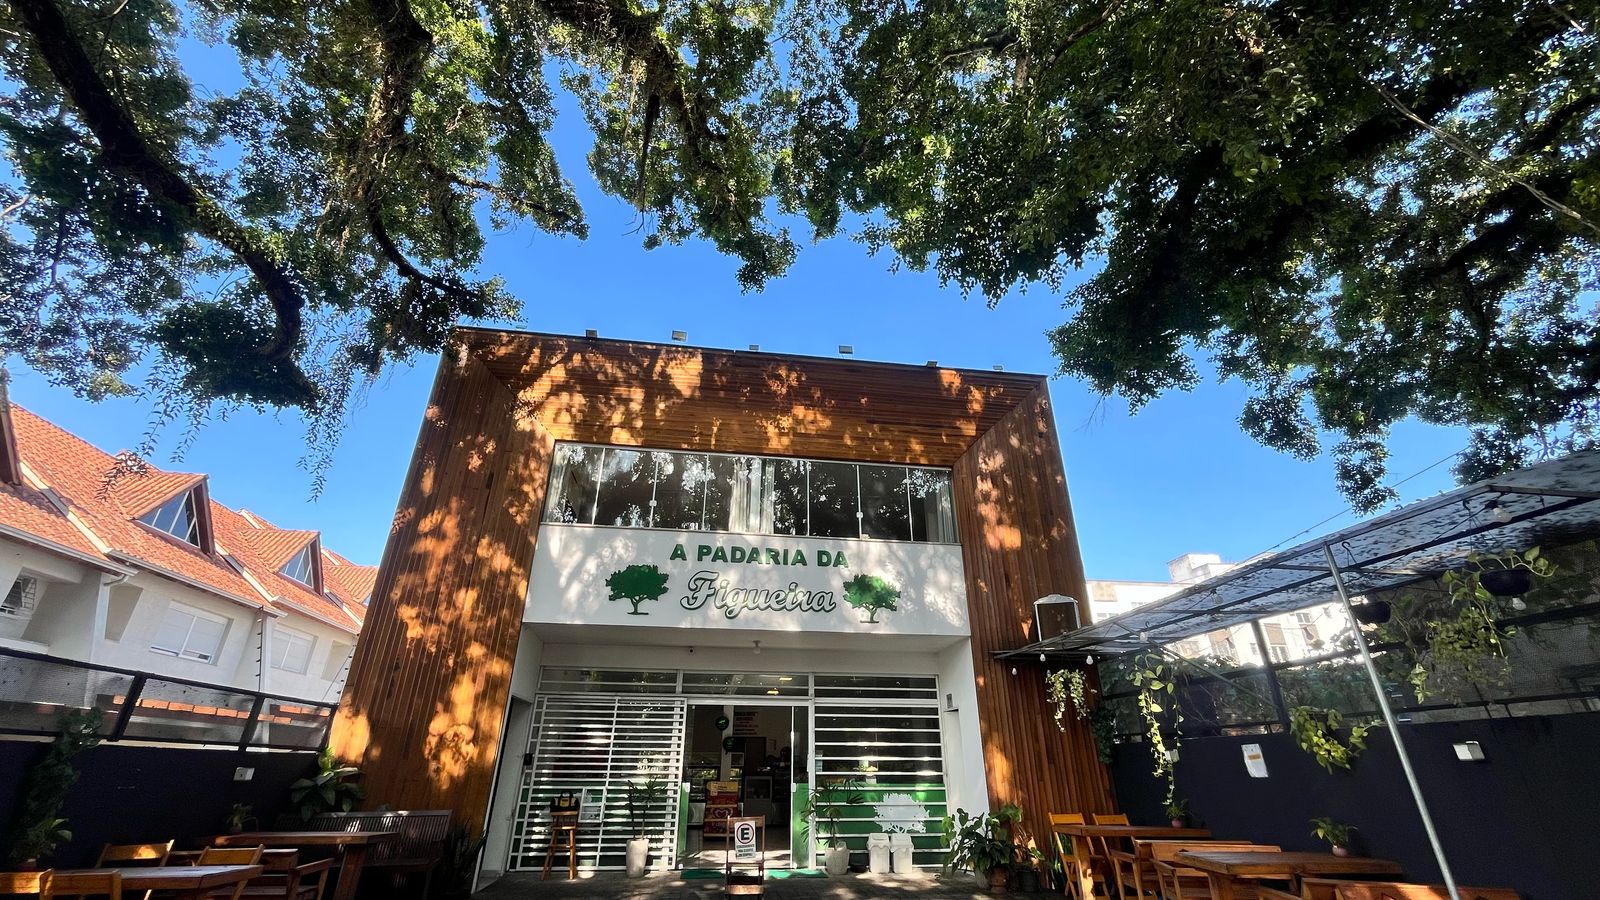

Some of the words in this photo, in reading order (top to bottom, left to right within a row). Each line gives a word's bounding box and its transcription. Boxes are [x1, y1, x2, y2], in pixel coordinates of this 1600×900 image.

[670, 544, 687, 561] A
[697, 544, 808, 567] PADARIA
[817, 550, 849, 568] DA
[680, 570, 837, 619] Figueira
[741, 827, 750, 841] E
